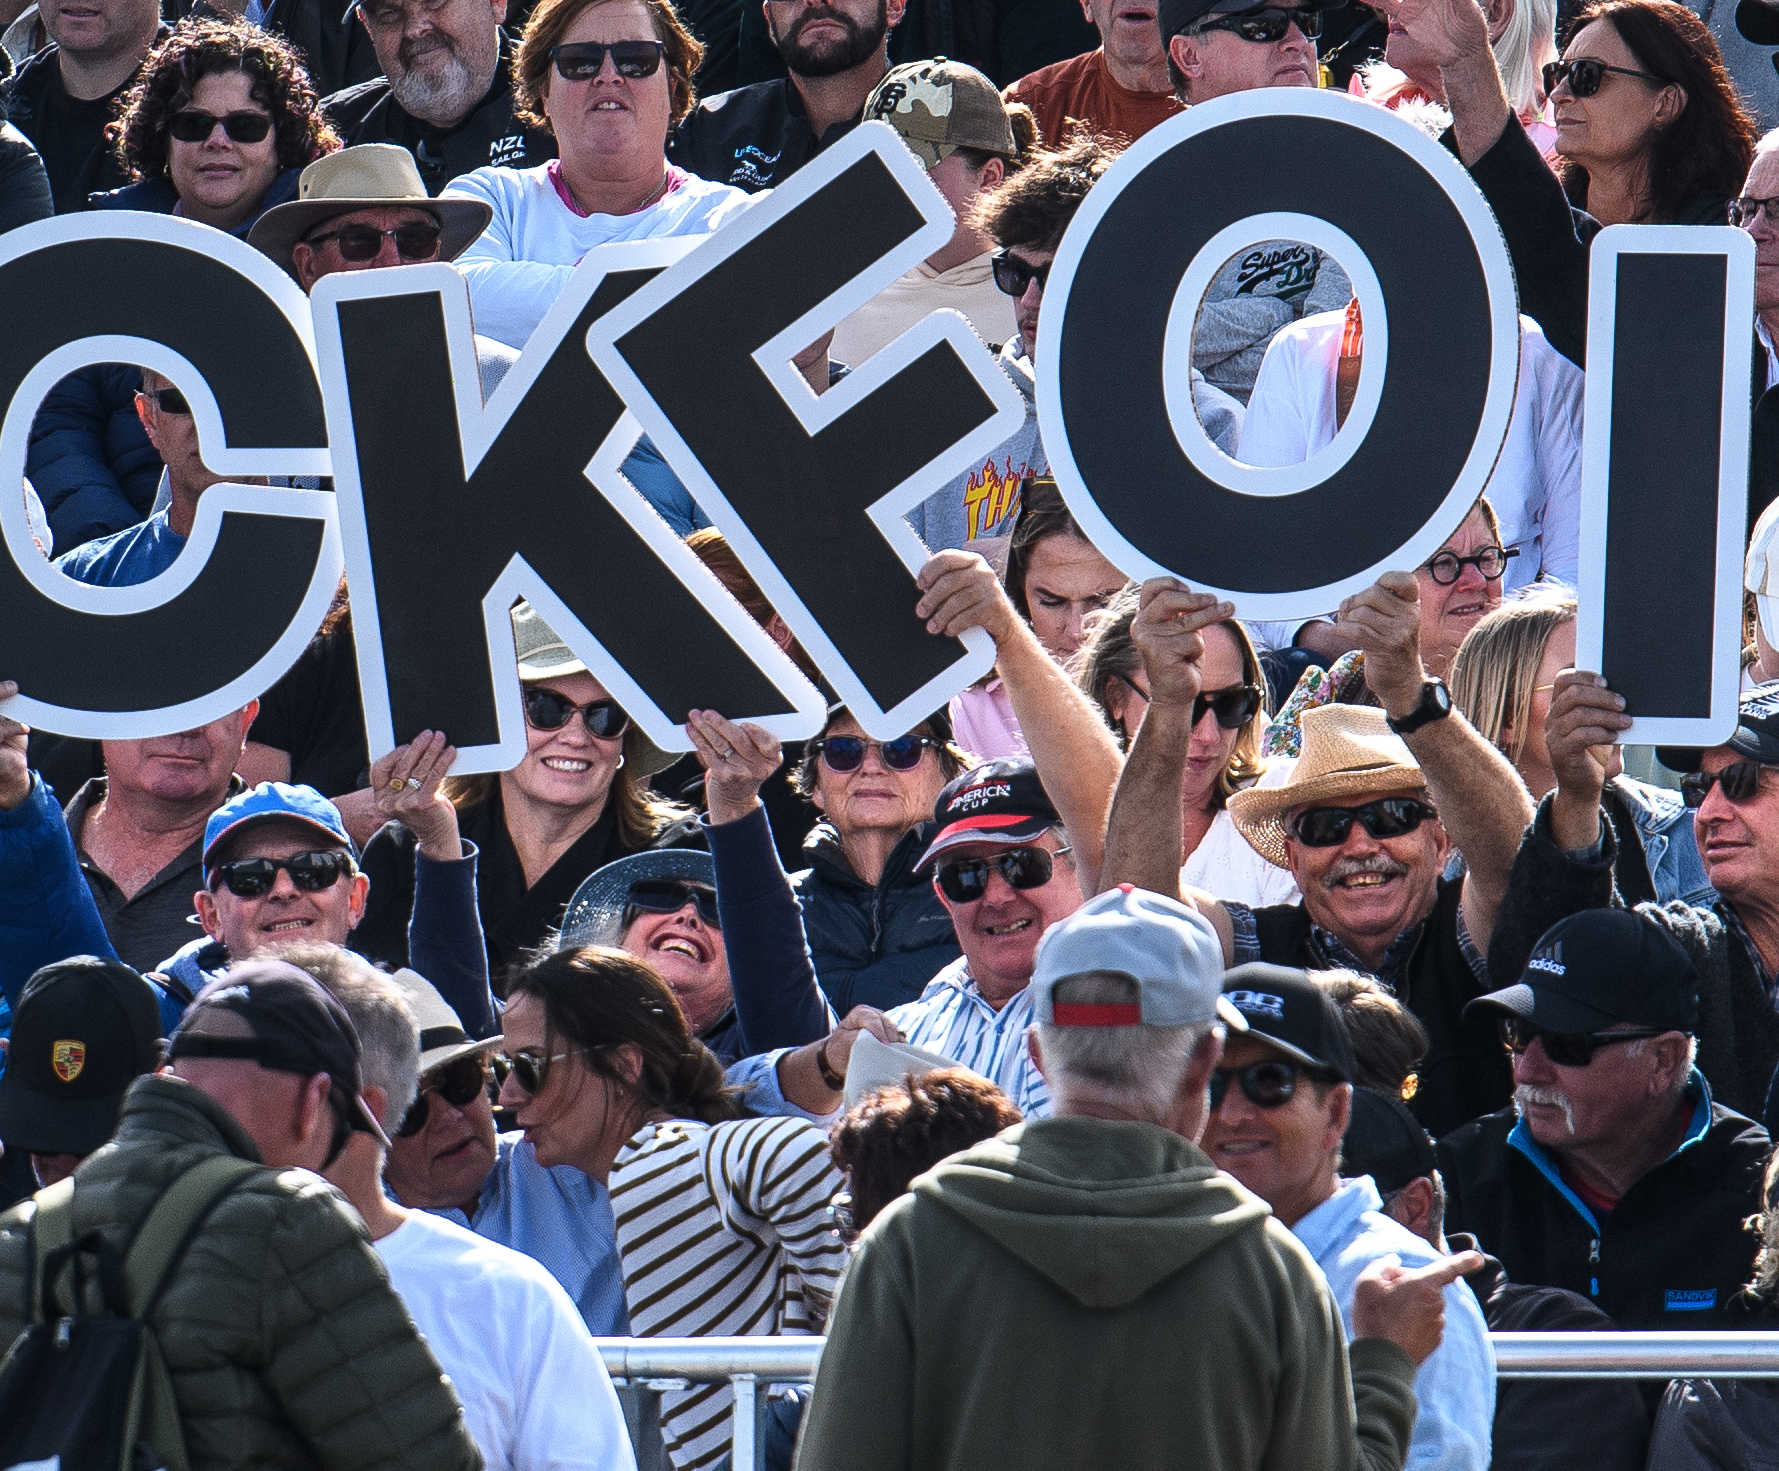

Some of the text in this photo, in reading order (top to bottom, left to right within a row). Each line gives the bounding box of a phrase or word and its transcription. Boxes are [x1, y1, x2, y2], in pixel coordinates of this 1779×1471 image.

[489, 135, 526, 159] NZL
[1528, 957, 1567, 976] adidas
[1667, 1290, 1717, 1302] SANDVIK
